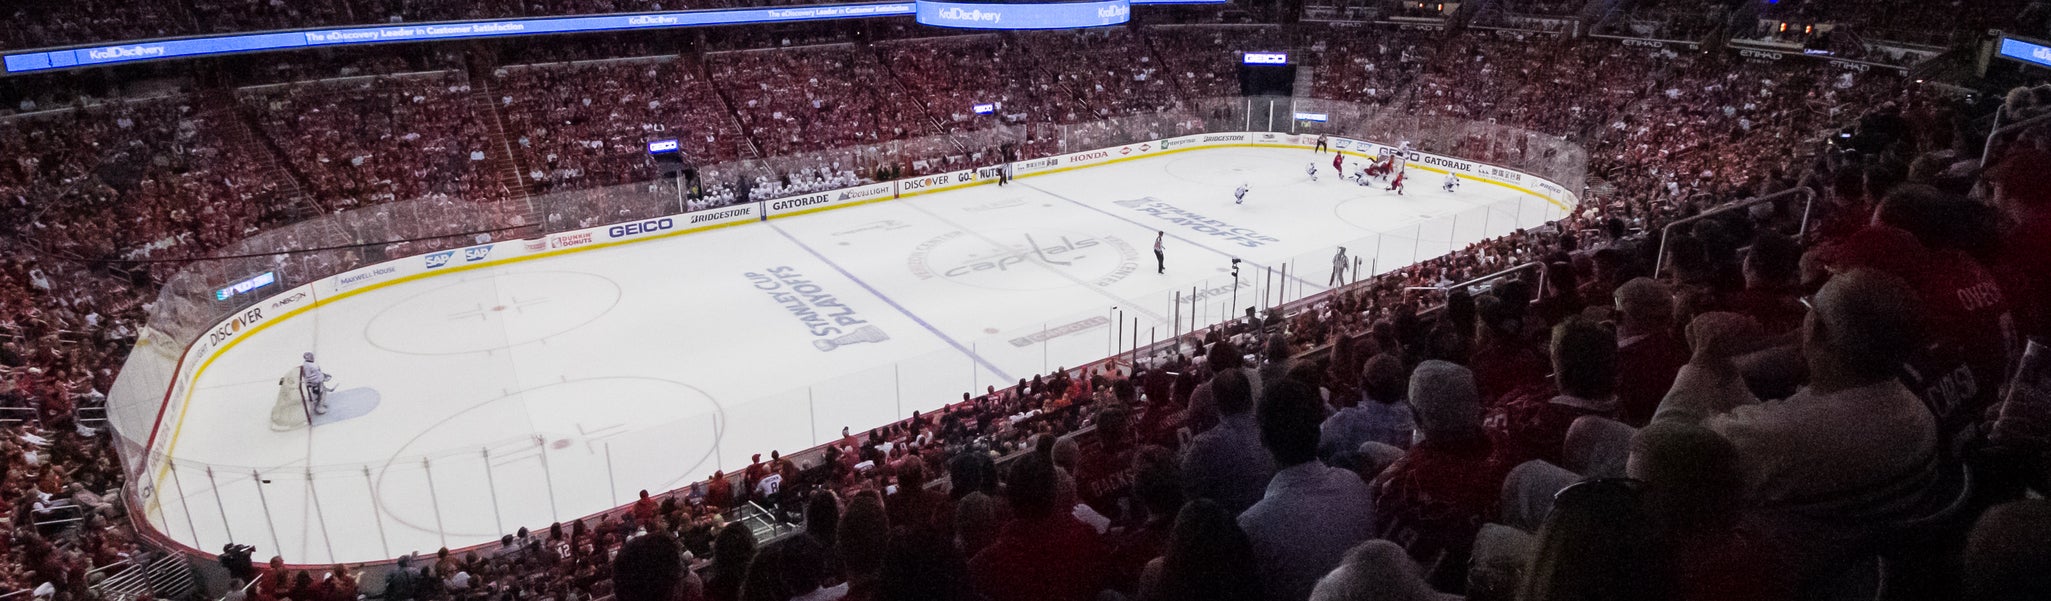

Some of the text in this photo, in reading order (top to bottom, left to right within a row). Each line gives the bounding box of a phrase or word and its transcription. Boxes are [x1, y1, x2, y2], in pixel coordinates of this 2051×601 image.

[305, 31, 325, 42] The
[380, 27, 414, 37] Leader
[416, 27, 425, 36] in
[426, 23, 471, 35] Customer
[472, 22, 525, 32] Satisfaction
[1740, 50, 1783, 60] ETIHAD
[1069, 151, 1109, 163] HONDA
[1424, 156, 1472, 172] GATORADE
[904, 175, 949, 190] DISCOVER
[772, 193, 829, 212] GATORADE
[691, 207, 751, 224] BRIDGESTONE
[609, 217, 674, 239] GEICO
[743, 271, 843, 337] STANLEY CUP
[765, 265, 868, 327] PLAYOFFS
[210, 307, 264, 347] DISCOVER
[556, 543, 572, 559] 12
